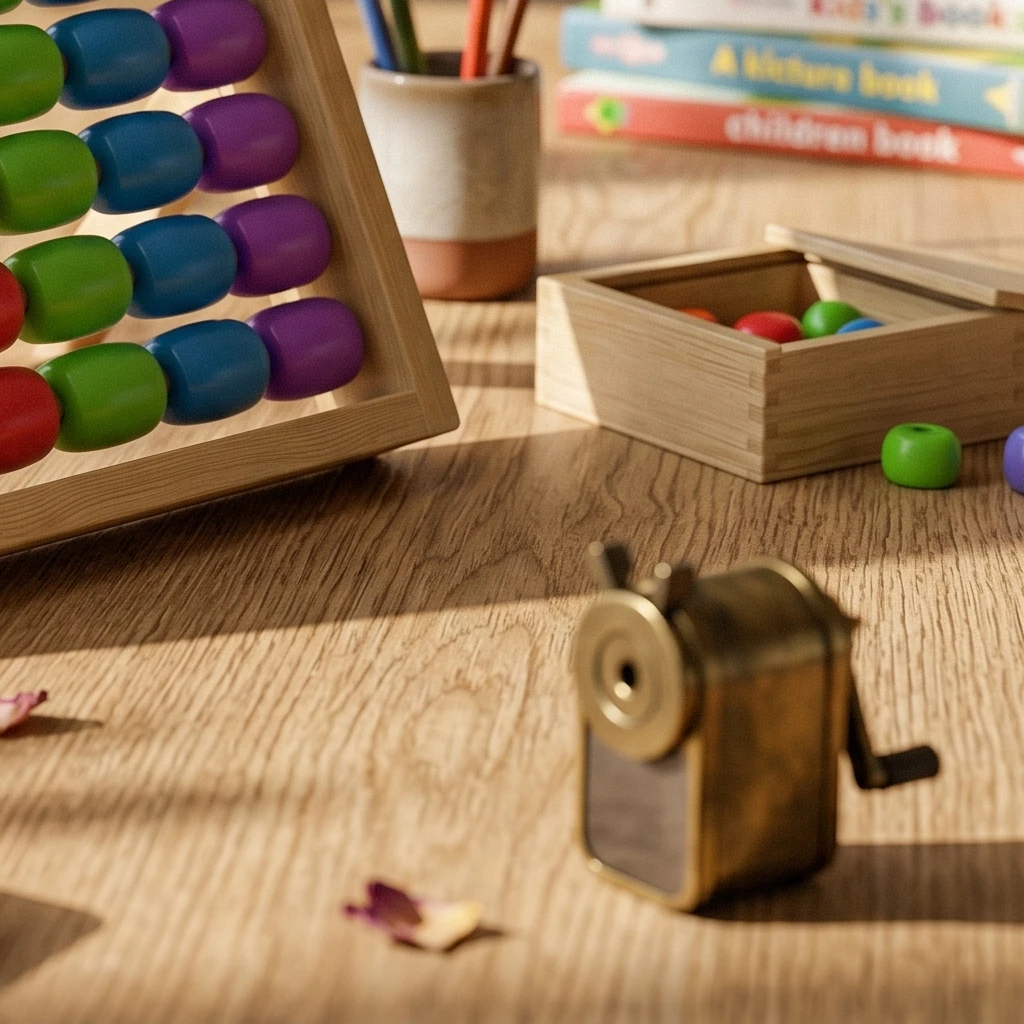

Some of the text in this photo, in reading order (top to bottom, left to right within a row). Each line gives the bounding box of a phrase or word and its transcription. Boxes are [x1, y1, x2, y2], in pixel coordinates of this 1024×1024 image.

[710, 43, 738, 76] A
[858, 60, 940, 106] book
[724, 108, 960, 164] children book
